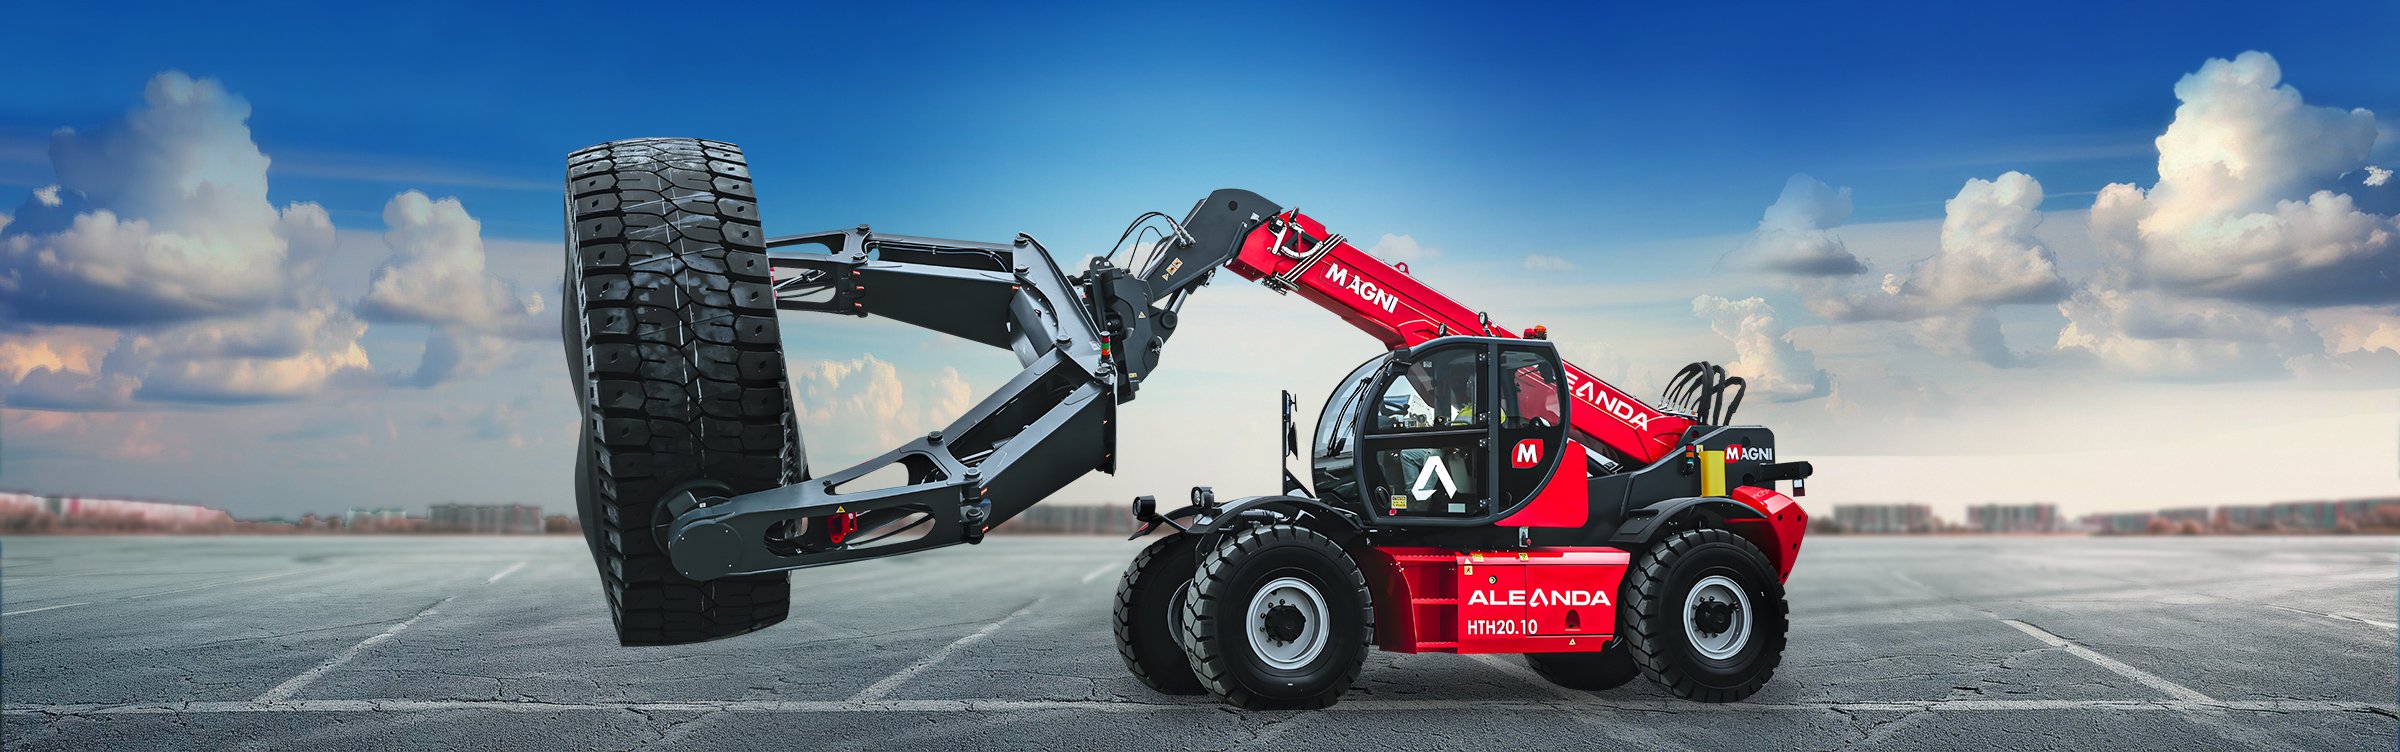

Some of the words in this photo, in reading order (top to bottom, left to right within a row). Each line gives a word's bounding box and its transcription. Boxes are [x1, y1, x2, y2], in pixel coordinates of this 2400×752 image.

[1325, 263, 1398, 314] MAGNI
[1517, 444, 1537, 463] M
[1726, 447, 1772, 460] MAGNI
[1468, 588, 1611, 607] ALEANDA
[1467, 619, 1538, 635] HTH20.10
